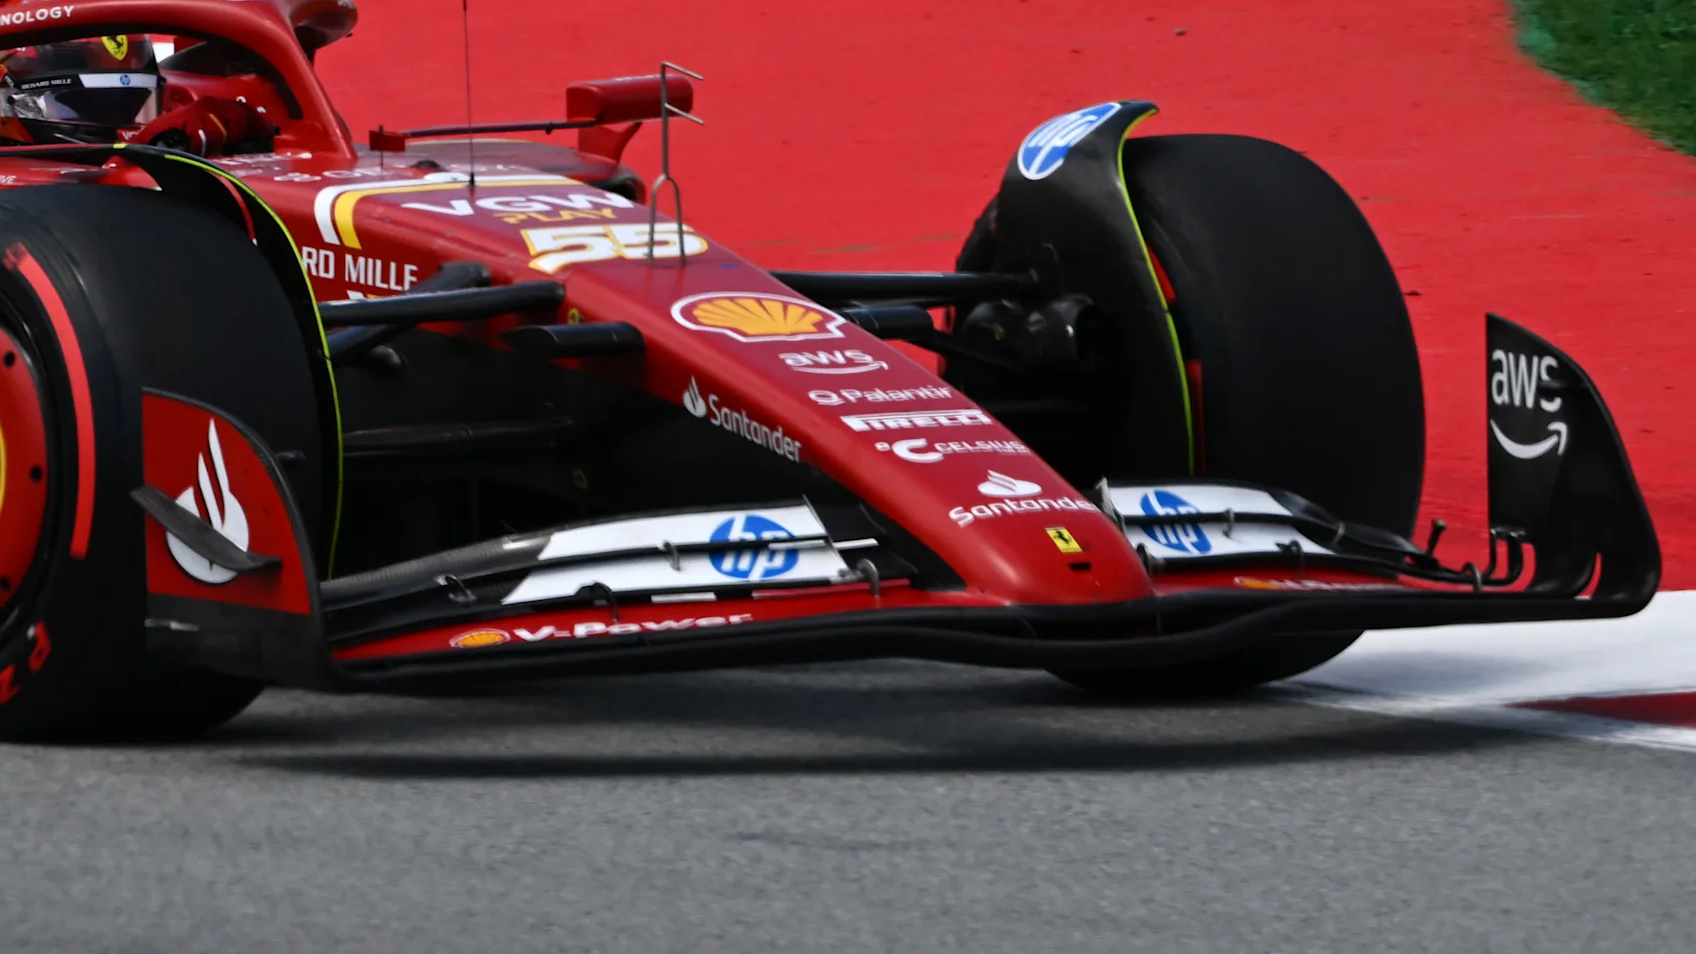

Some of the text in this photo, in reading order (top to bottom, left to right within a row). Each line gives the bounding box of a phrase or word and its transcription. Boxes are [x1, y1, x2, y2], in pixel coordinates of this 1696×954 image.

[401, 193, 634, 217] VGW
[494, 208, 618, 224] PLAY
[520, 222, 708, 275] 55
[778, 349, 874, 367] aws
[840, 385, 953, 403] Palantir
[1491, 349, 1562, 413] aws
[709, 393, 801, 464] Santander
[840, 409, 992, 432] PIRELLI
[934, 440, 1025, 454] CELSIUS
[716, 514, 795, 580] hp
[513, 614, 753, 643] V-Power
[29, 620, 52, 674] P
